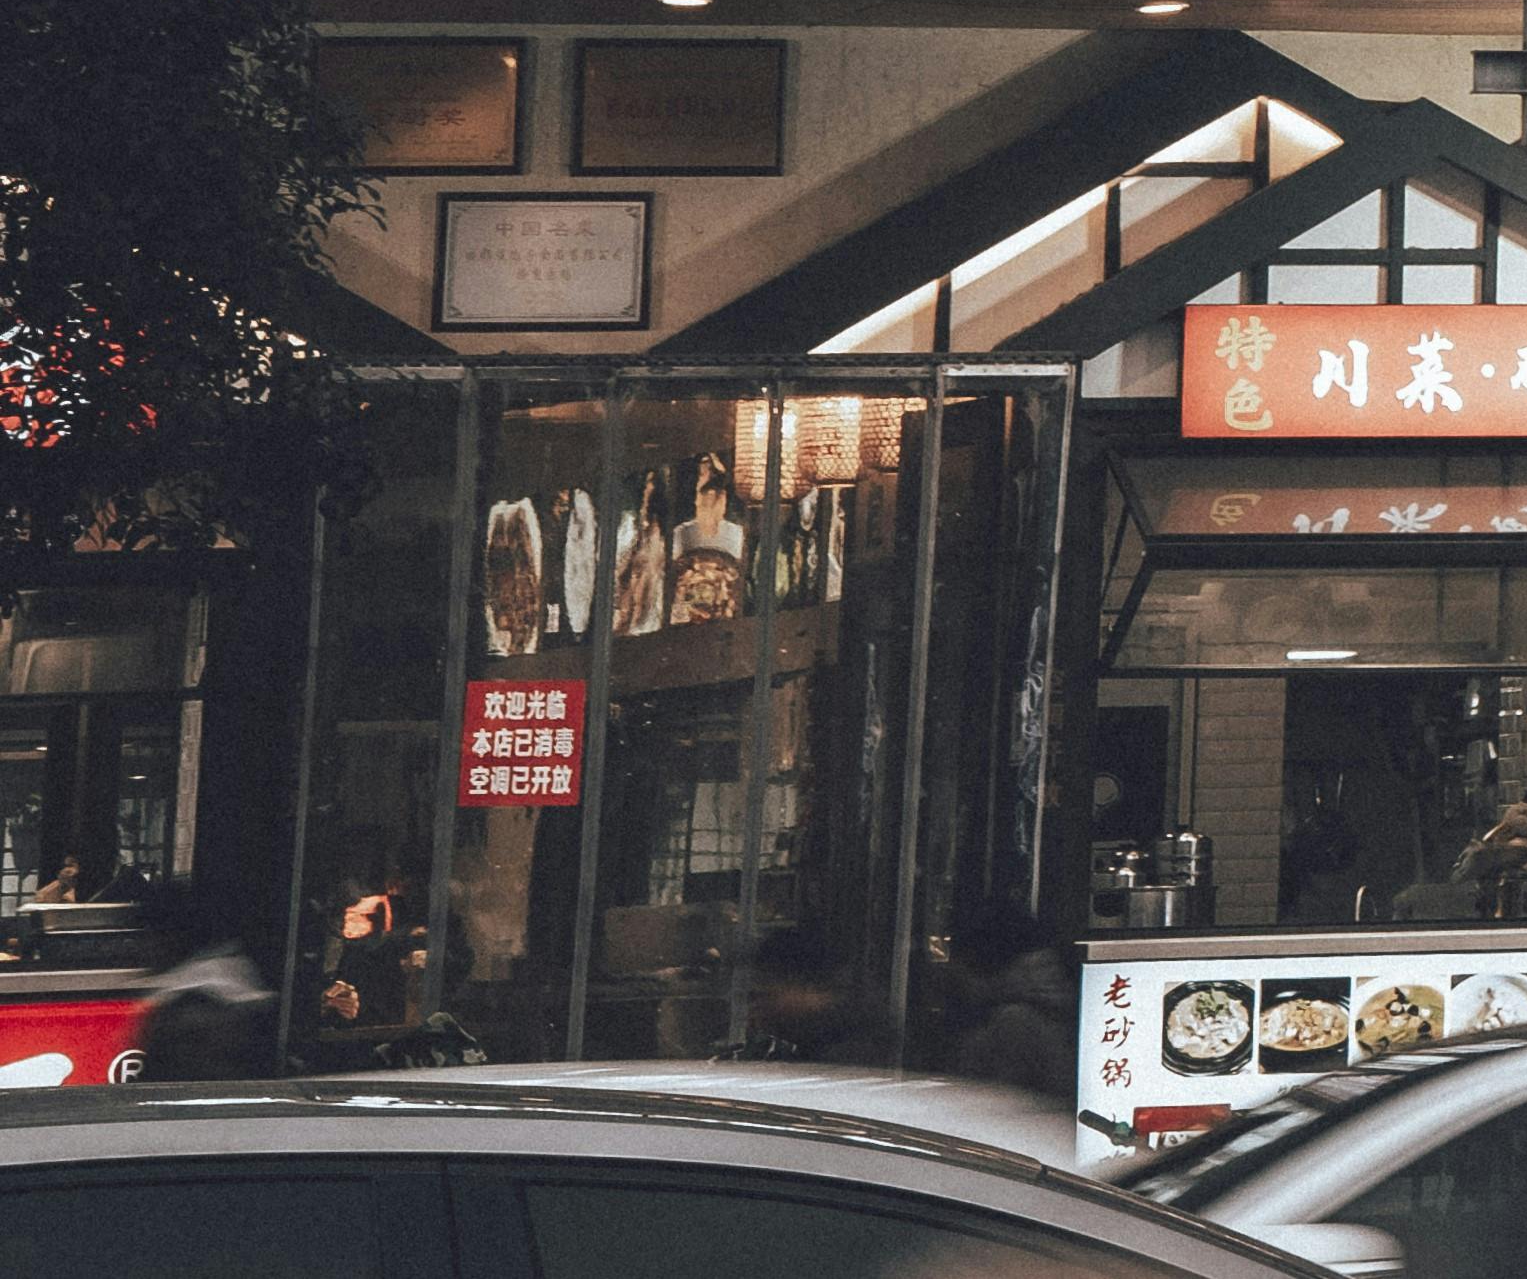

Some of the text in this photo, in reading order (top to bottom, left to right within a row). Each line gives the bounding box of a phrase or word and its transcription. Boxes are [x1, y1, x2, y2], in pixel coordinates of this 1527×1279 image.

[1214, 316, 1277, 432] 特色
[484, 689, 567, 720] 欢迎光临
[471, 727, 575, 758] 本店已消毒
[468, 764, 573, 795] 空调已开放
[1101, 974, 1135, 1088] 老砂锅
